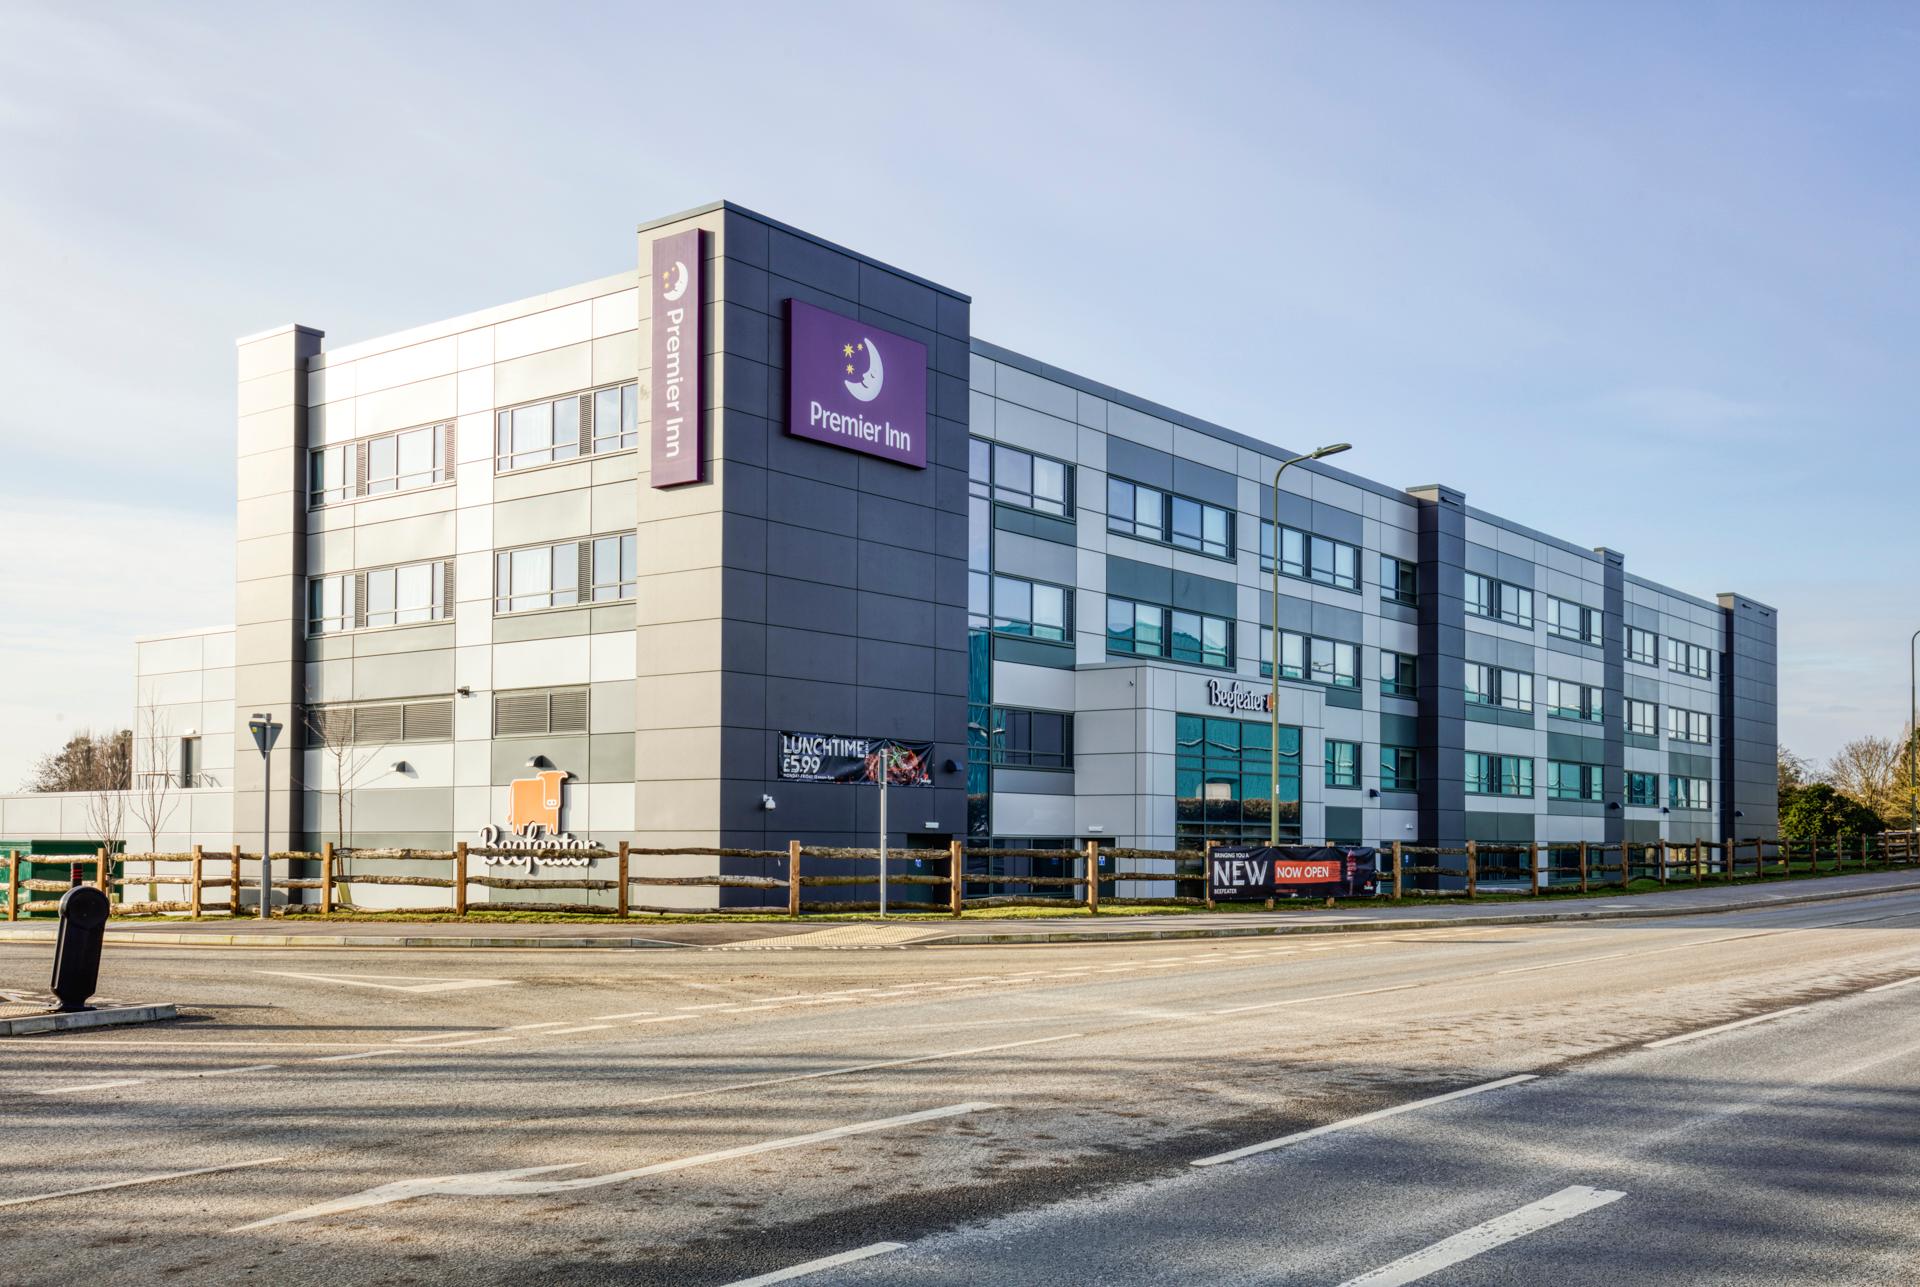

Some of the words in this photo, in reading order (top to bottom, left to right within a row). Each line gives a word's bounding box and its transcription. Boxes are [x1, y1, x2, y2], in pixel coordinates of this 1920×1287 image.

[665, 308, 684, 411] Premier
[665, 416, 684, 458] Inn
[810, 401, 882, 443] Premier
[885, 421, 911, 452] Inn
[1209, 678, 1266, 714] Beefeater
[783, 735, 865, 759] LUNCHTIME
[783, 755, 820, 774] £5.99
[1213, 860, 1268, 886] NEW
[1277, 866, 1303, 878] NOW
[1304, 866, 1329, 878] OPEN
